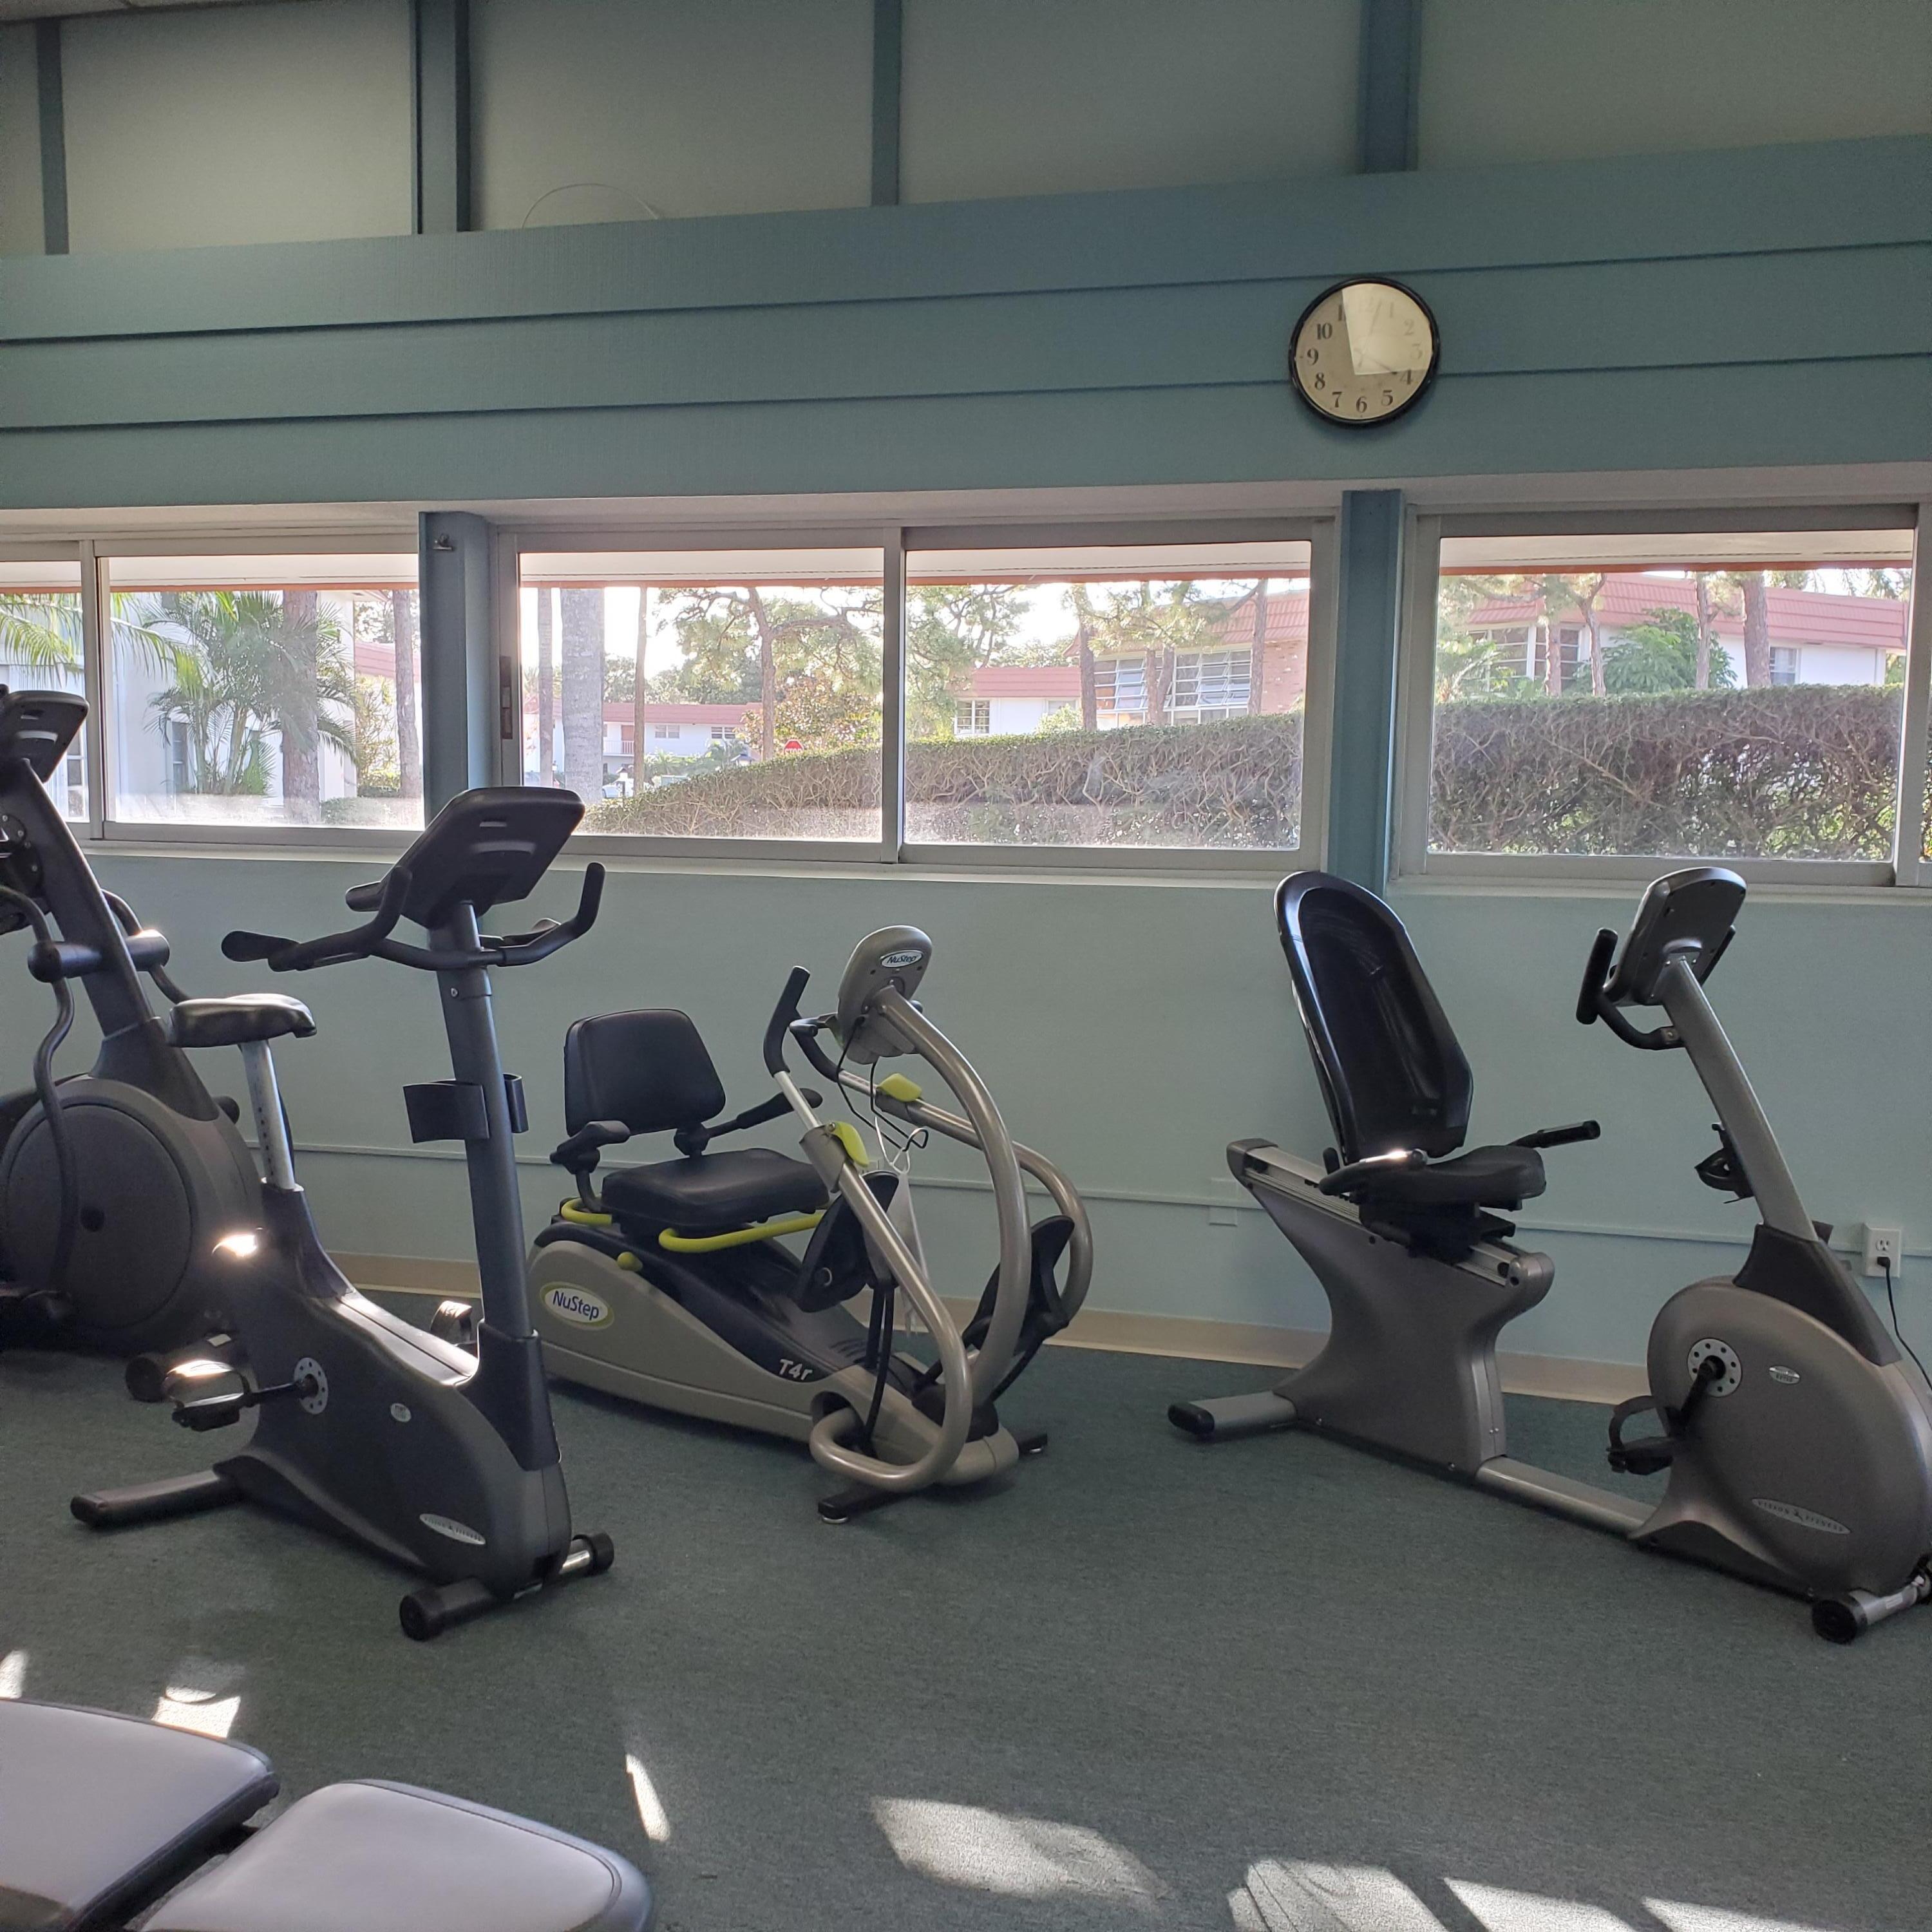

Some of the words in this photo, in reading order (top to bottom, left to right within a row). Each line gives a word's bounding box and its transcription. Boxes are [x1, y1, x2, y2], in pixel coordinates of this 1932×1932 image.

[1316, 323, 1333, 340] 10
[1404, 319, 1416, 336] 2
[1307, 348, 1319, 366] 9
[1314, 372, 1326, 390] 8
[1399, 369, 1414, 385] 4
[1332, 391, 1343, 408] 7
[1356, 396, 1368, 413] 6
[1381, 390, 1394, 406] 5
[887, 954, 917, 964] NuStep
[553, 1290, 600, 1321] NuStep
[779, 1359, 813, 1381] T4r
